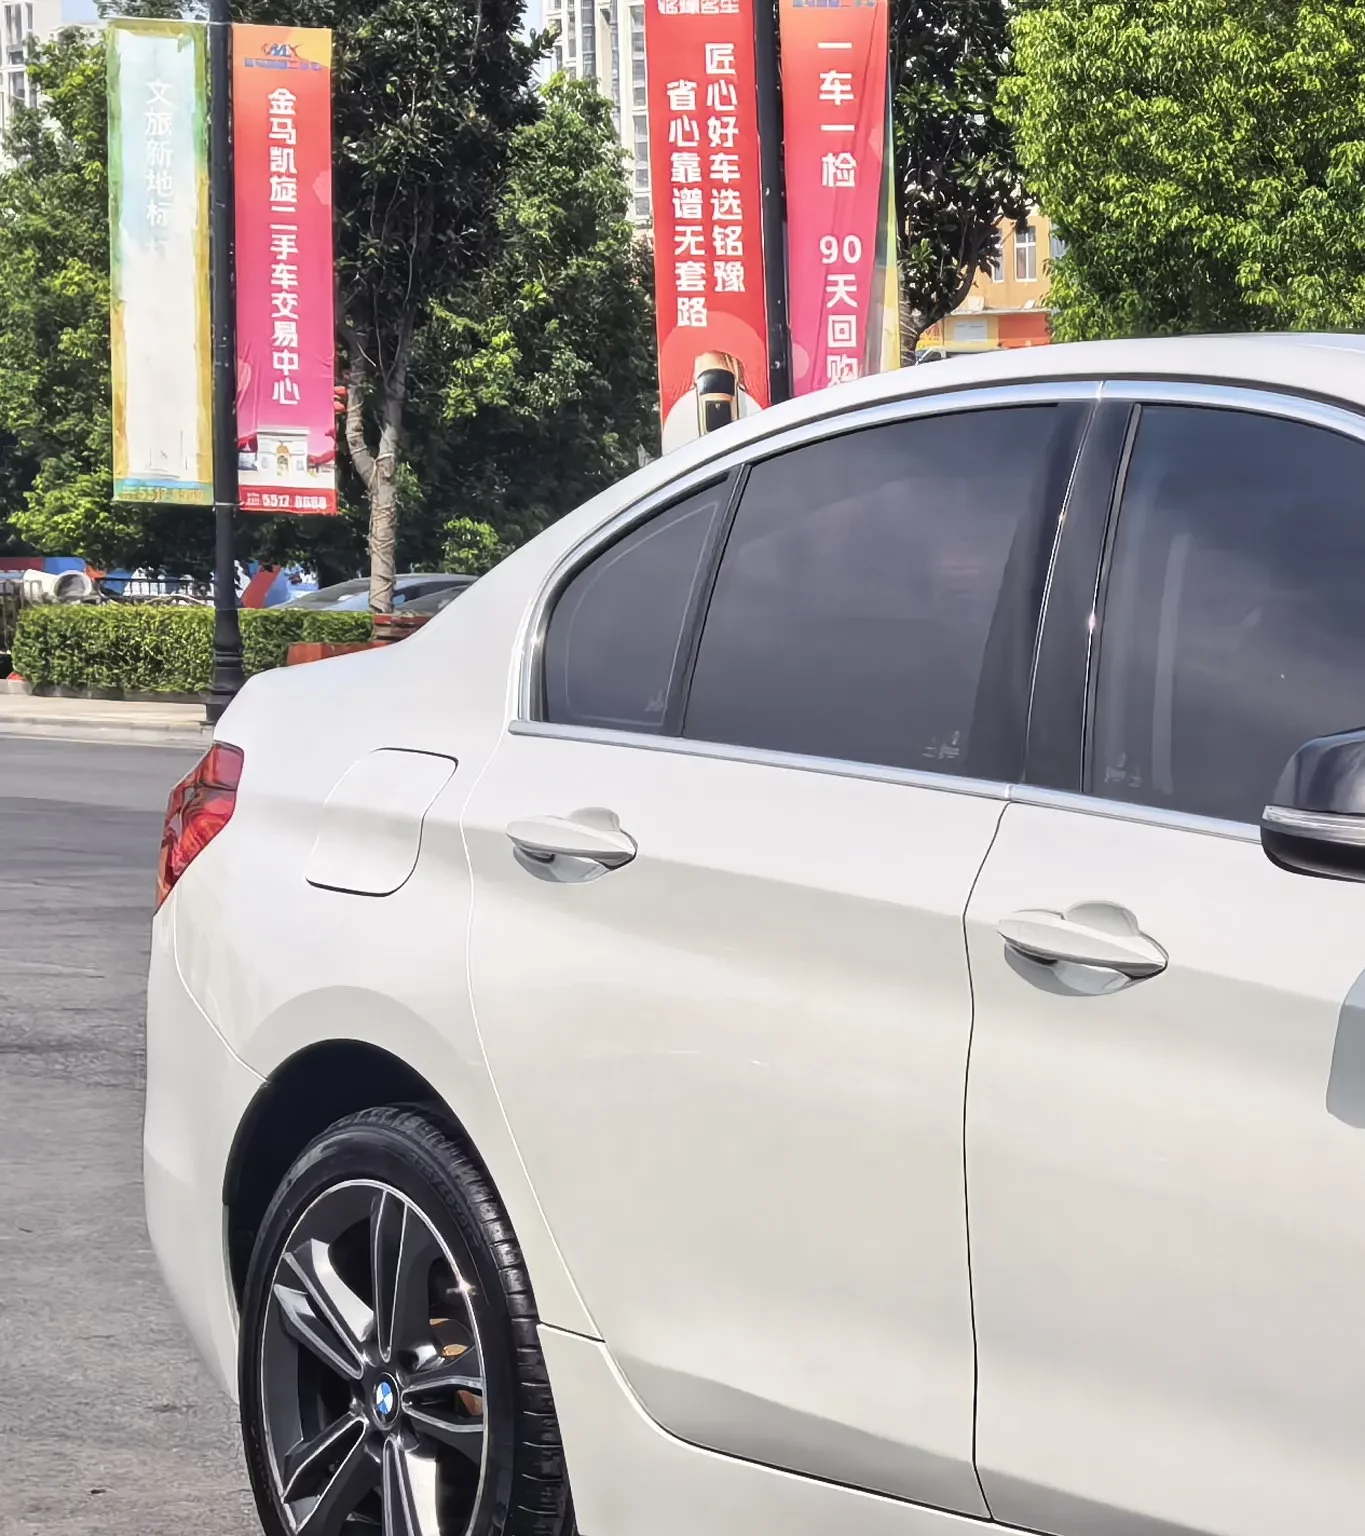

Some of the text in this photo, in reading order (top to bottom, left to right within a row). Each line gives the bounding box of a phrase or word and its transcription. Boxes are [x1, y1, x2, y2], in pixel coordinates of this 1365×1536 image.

[144, 78, 174, 259] 文旅新地标
[666, 79, 708, 328] 省心靠谱无套路
[704, 42, 745, 294] 匠心好车选铭豫
[817, 41, 858, 189] 一车一检
[267, 87, 300, 406] 金马凯旋二手车交易中心
